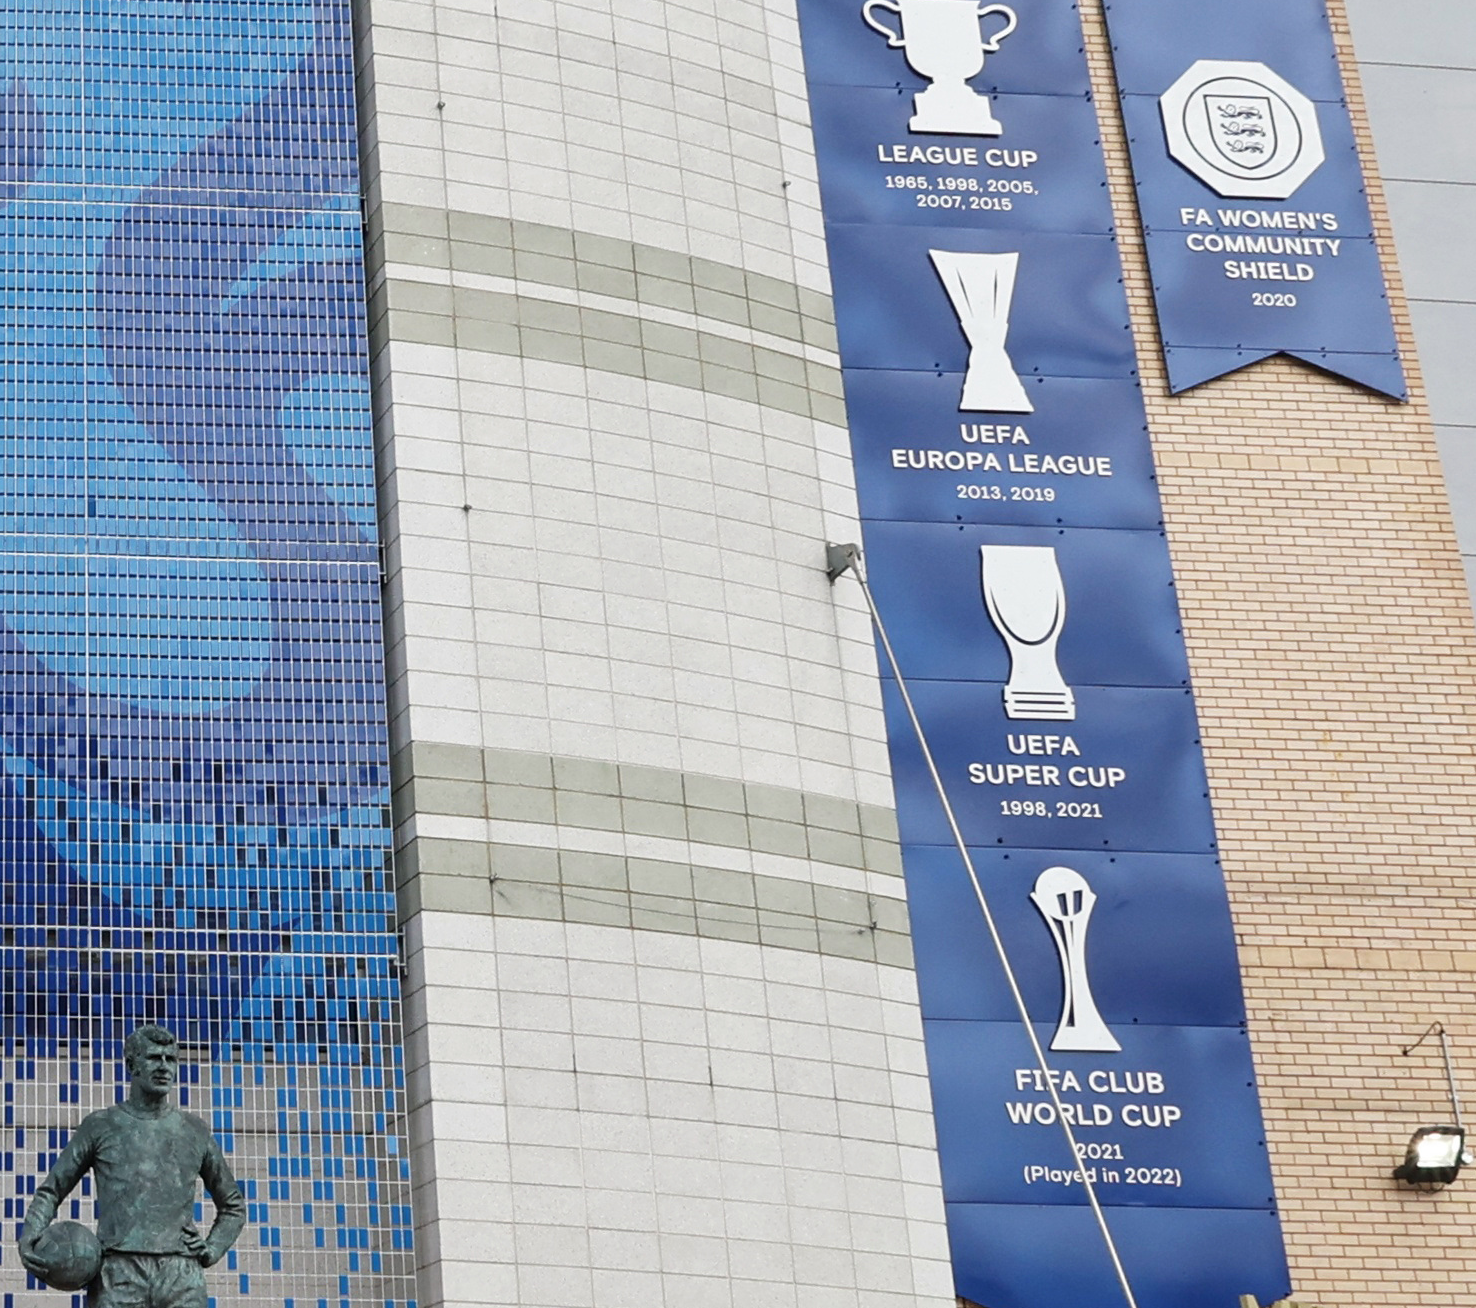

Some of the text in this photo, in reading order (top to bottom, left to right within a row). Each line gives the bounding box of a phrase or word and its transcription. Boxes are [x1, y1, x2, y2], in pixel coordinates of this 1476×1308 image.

[877, 144, 1038, 168] LEAGUE CUP
[885, 175, 1039, 196] 1965, 1998, 2005,
[916, 194, 1013, 211] 2007, 2015
[1180, 207, 1338, 231] FA WOMEN'S
[1186, 233, 1341, 256] COMMUNITY
[1224, 260, 1315, 281] SHIELD
[1251, 292, 1297, 307] 2020
[960, 423, 1031, 445] UEFA
[891, 449, 1113, 476] EUROPA LEAGUE
[956, 484, 1056, 502] 2013, 2019
[1007, 734, 1081, 756] UEFA
[968, 762, 1126, 788] SUPER CUP
[1000, 800, 1103, 818] 1998, 2021
[1087, 1070, 1165, 1095] CLUB
[1005, 1101, 1182, 1128] WORLD CUP
[1075, 1142, 1125, 1160] 2021
[1023, 1164, 1182, 1188] (Played in 2022)
